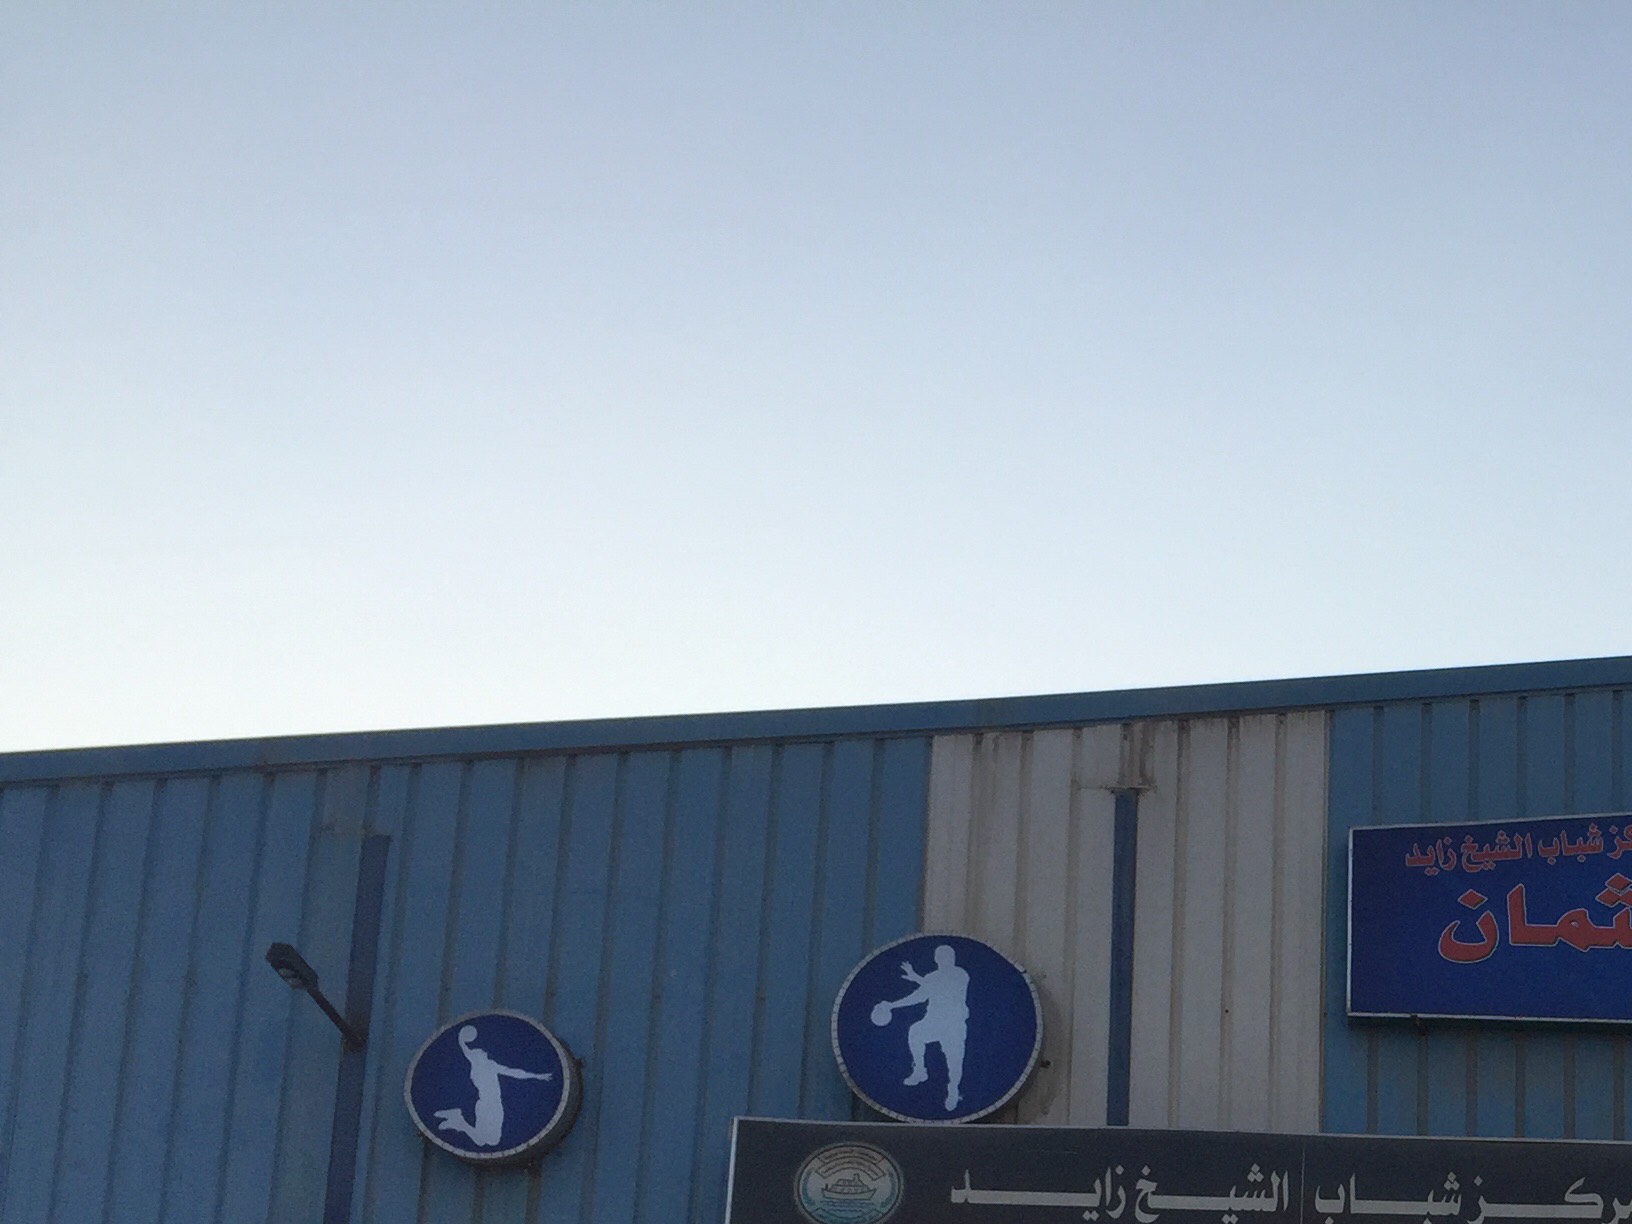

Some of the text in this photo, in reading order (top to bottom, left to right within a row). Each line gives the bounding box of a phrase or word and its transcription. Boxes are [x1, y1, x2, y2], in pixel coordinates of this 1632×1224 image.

[1405, 836, 1458, 876] زايد
[1460, 829, 1533, 873] الشيخ
[1537, 823, 1604, 865] شباب
[951, 1164, 1127, 1222] زايد
[1134, 1162, 1290, 1224] الشيخ
